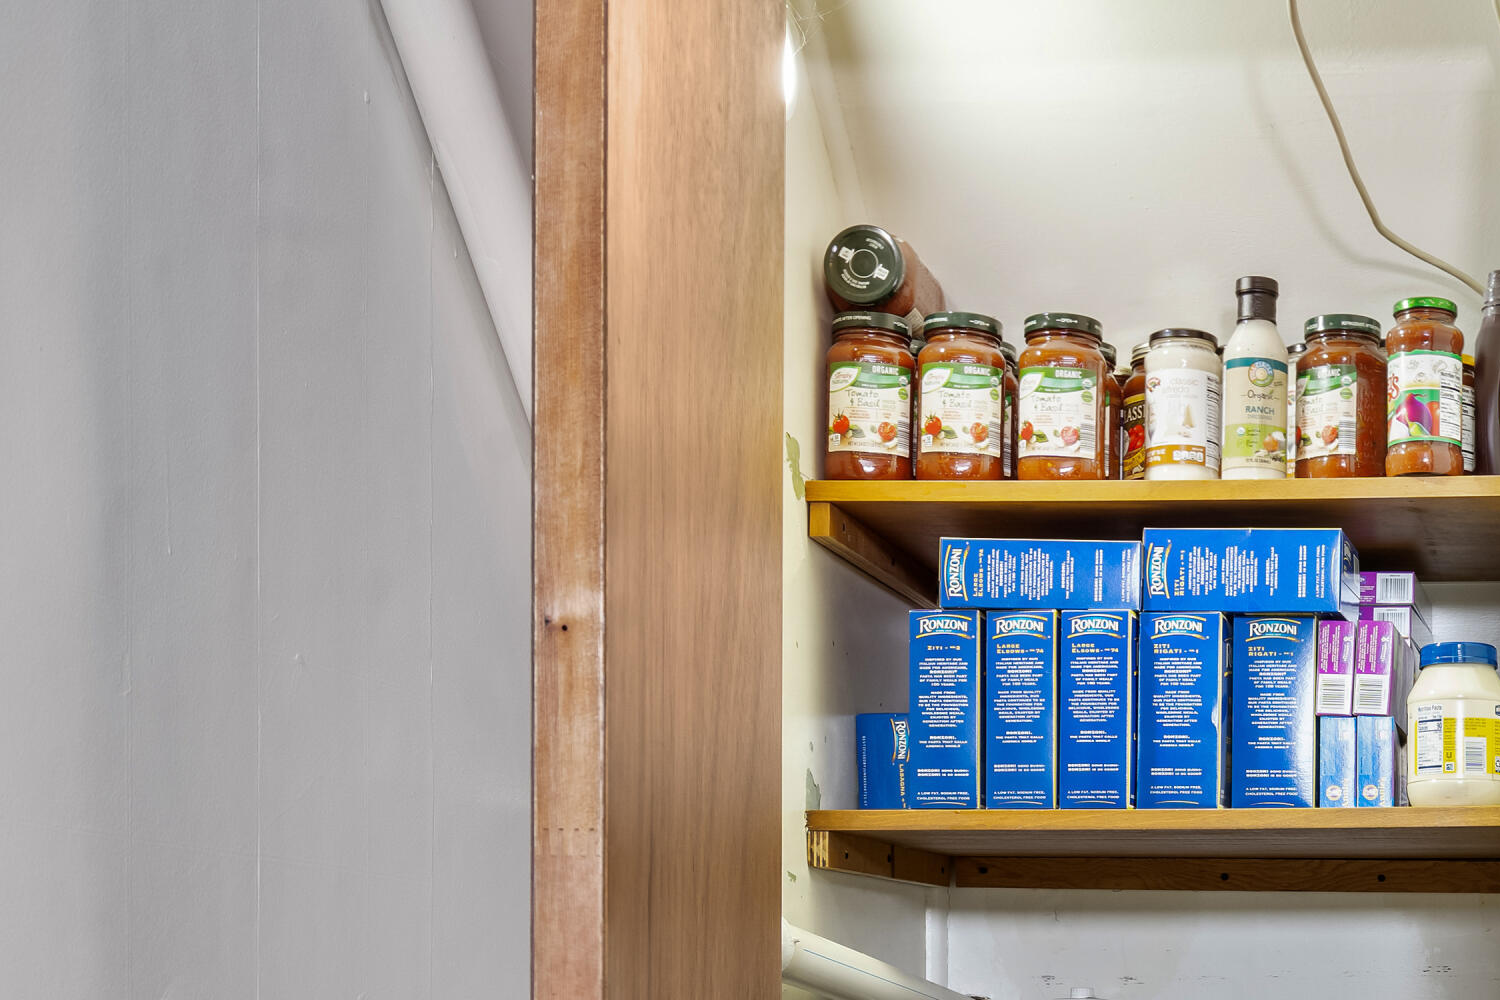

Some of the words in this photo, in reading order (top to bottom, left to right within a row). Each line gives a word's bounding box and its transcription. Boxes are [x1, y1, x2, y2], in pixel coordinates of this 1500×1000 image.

[872, 366, 900, 376] ORGANIC
[964, 366, 991, 376] ORGANIC
[1055, 369, 1082, 378] ORGANIC
[846, 388, 879, 398] Tomato
[857, 398, 880, 408] Basil
[1246, 406, 1274, 416] RANCH
[948, 548, 963, 597] RONZONI
[1150, 546, 1165, 595] RONZONI
[920, 618, 968, 634] RONZONI
[996, 619, 1044, 634] RONZONI
[1072, 618, 1119, 634] RONZONI
[1154, 619, 1203, 634] RONZONI
[1250, 622, 1297, 637] RONZONI
[894, 720, 906, 760] RONZONI
